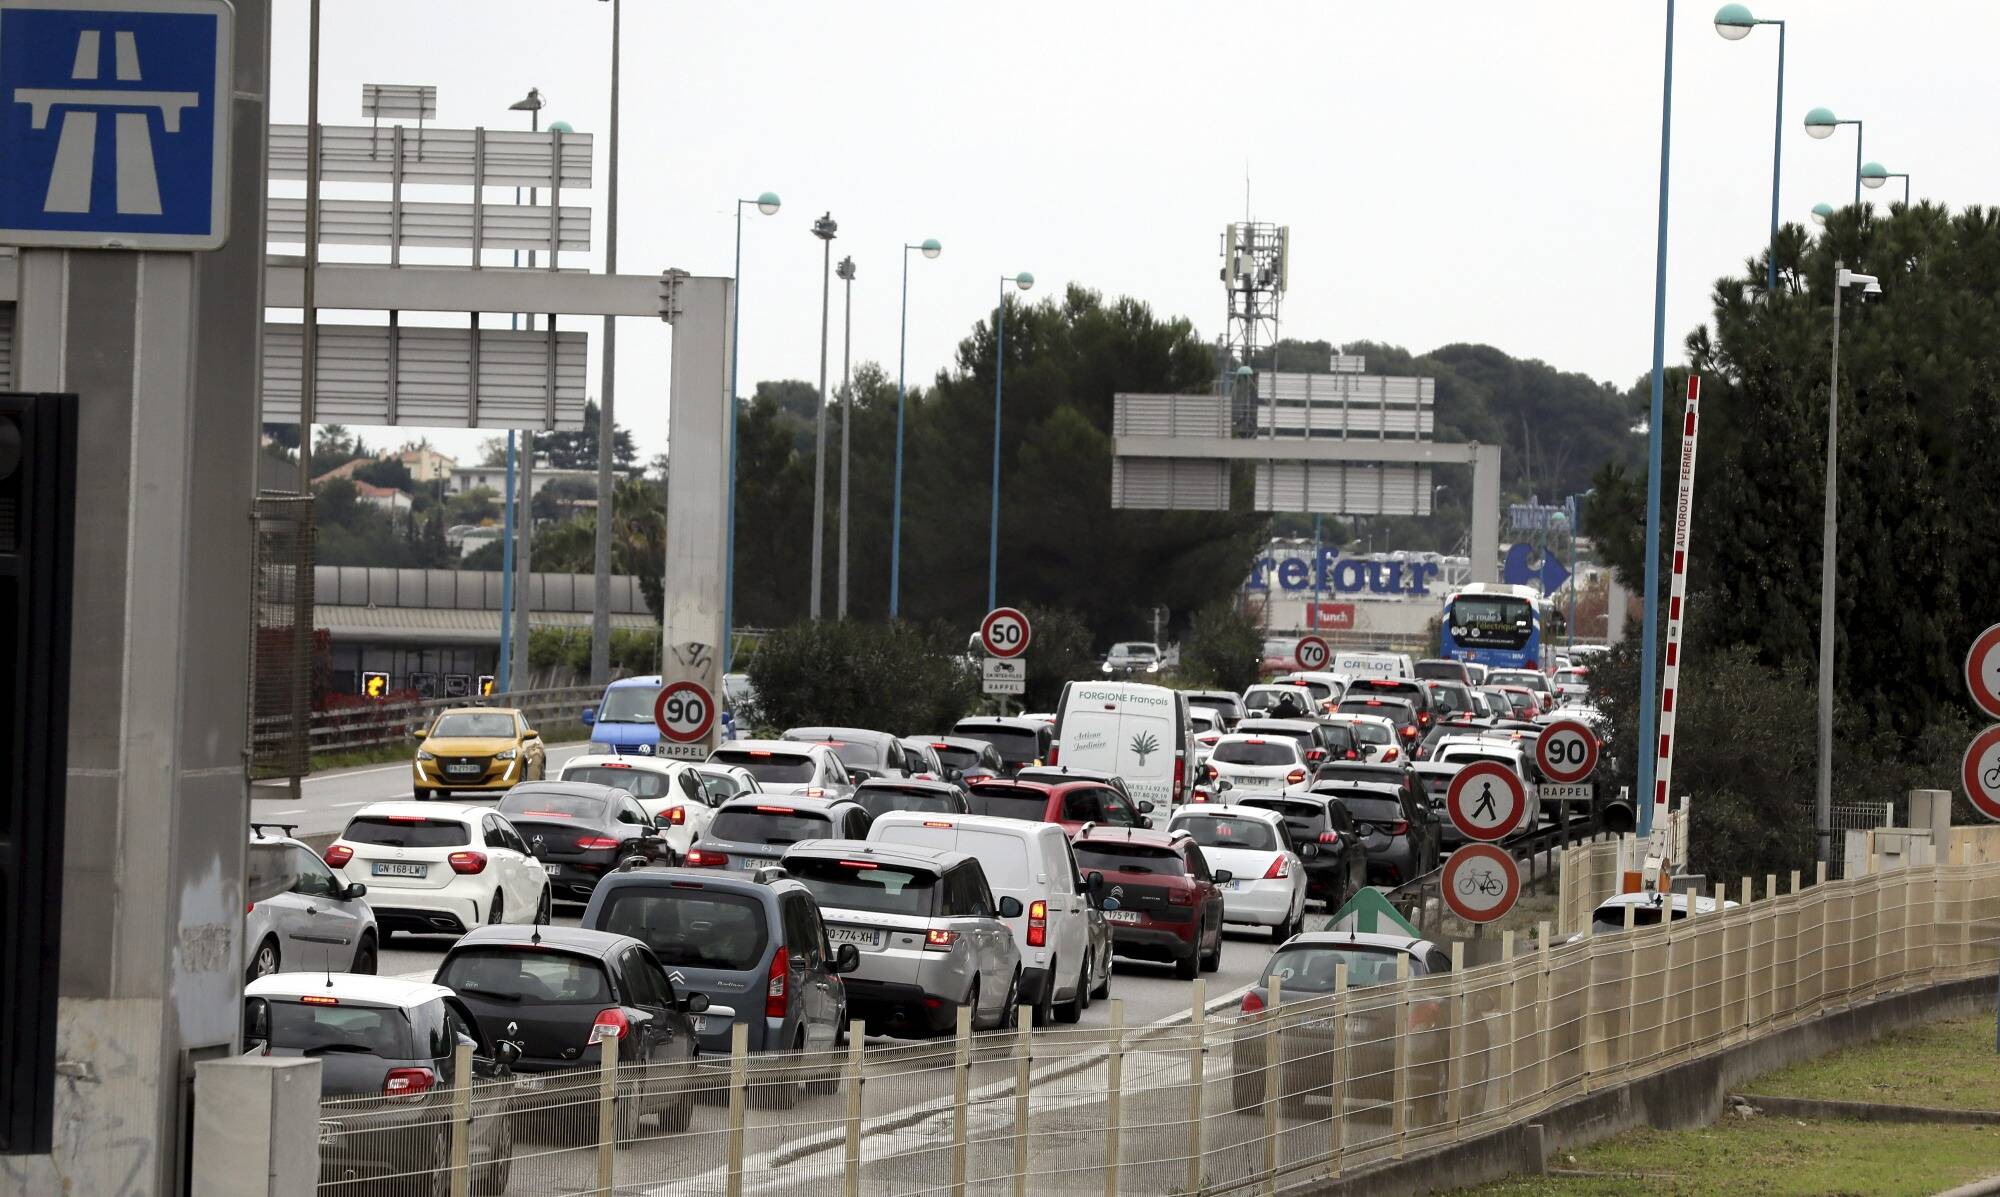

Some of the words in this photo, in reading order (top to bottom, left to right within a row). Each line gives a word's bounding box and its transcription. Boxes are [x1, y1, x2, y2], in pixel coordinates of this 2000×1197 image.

[1682, 440, 1693, 480] FERMEE
[1676, 486, 1689, 546] AUTOROUTE
[1247, 546, 1439, 595] refour
[992, 624, 1020, 644] 50
[1303, 646, 1323, 661] 70
[1079, 691, 1128, 702] FORGIONE
[1129, 694, 1169, 707] François
[666, 698, 703, 724] 90
[659, 746, 704, 757] RAPPEL
[1548, 739, 1586, 765] 90
[1543, 787, 1589, 797] RAPPEL
